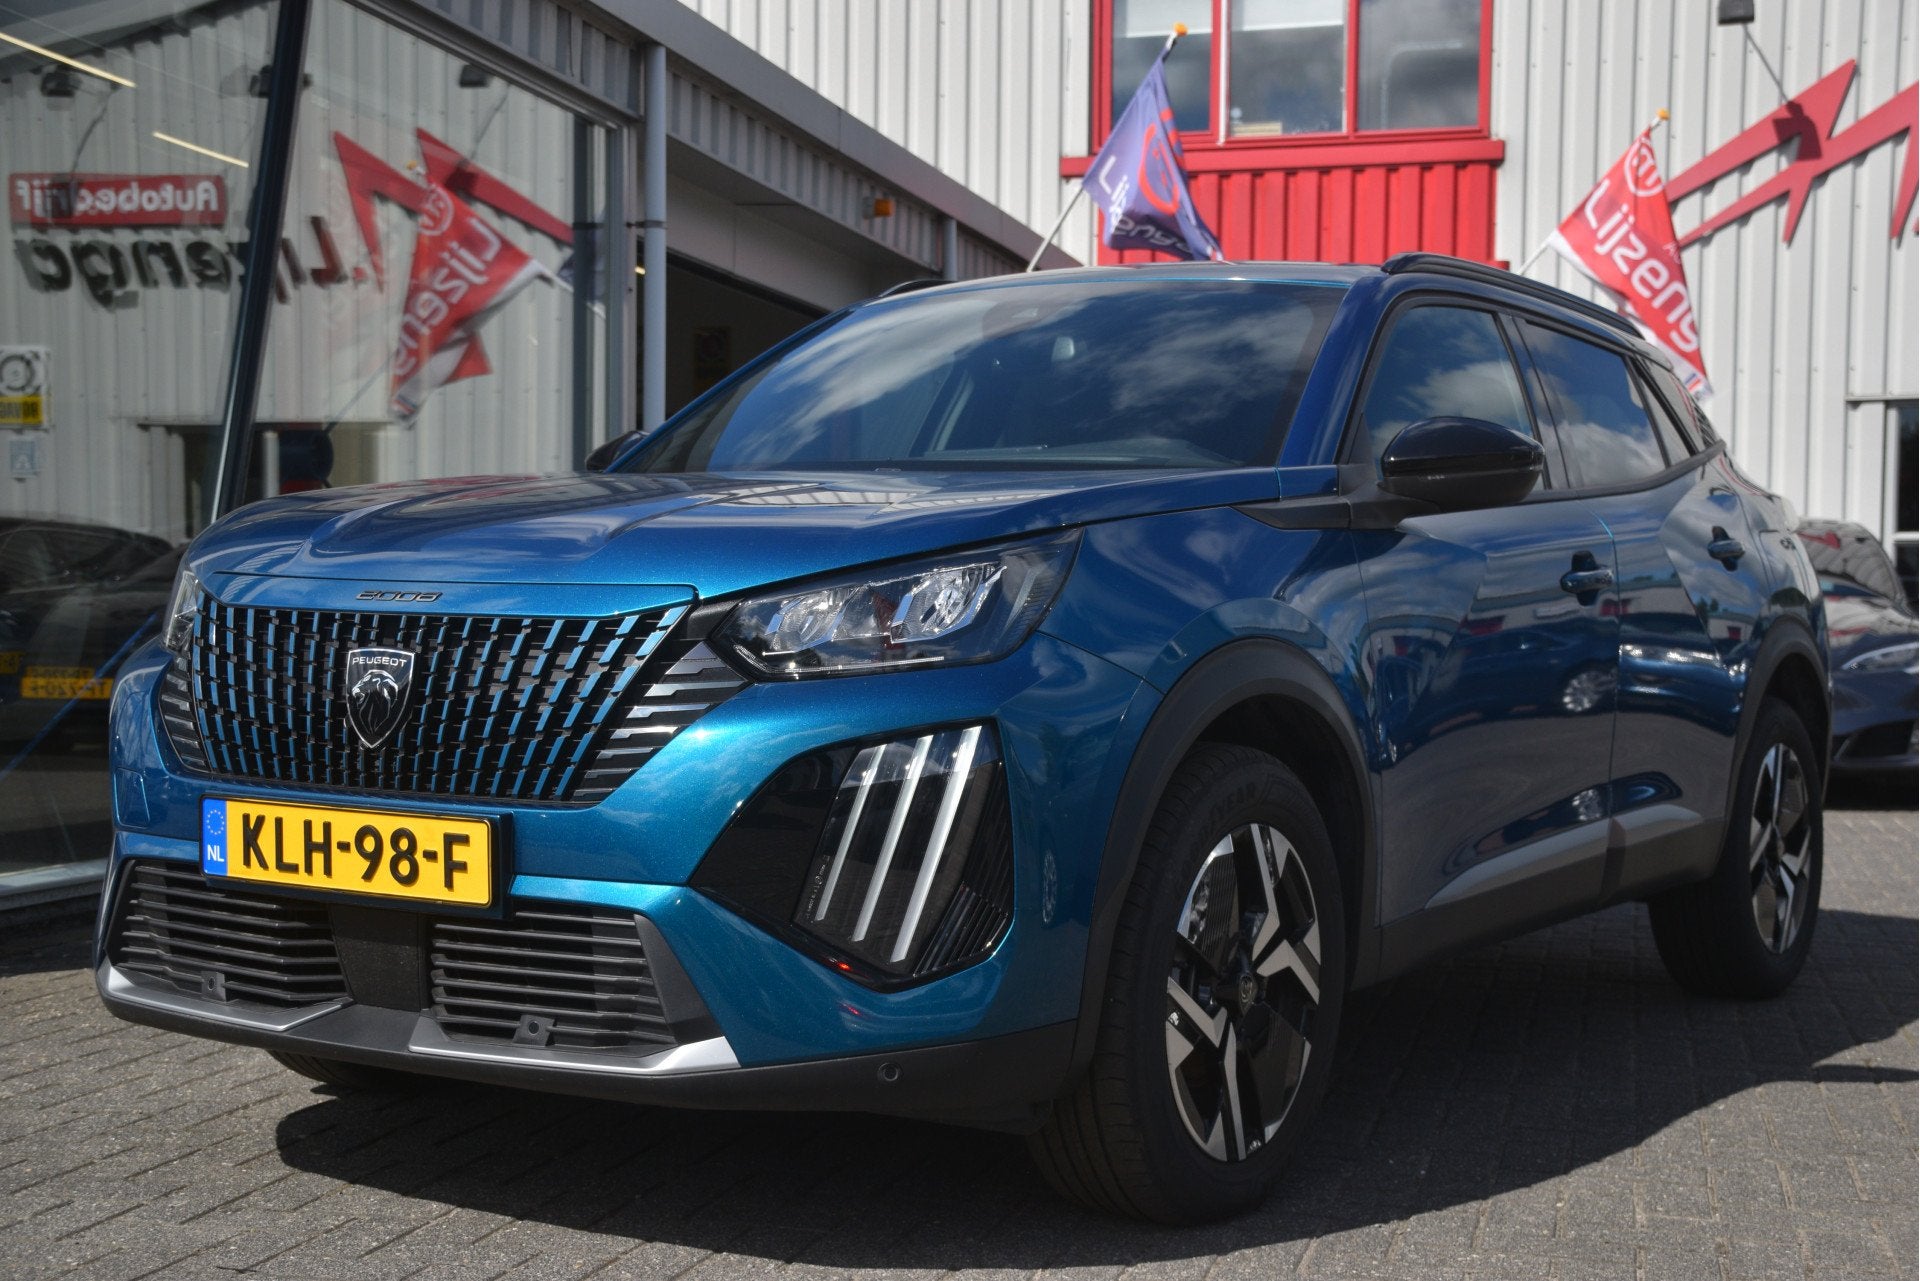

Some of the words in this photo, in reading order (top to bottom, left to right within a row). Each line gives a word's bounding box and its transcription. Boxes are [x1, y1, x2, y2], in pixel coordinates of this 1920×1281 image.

[355, 590, 443, 603] 2008
[351, 656, 408, 667] PEUGEOT
[206, 843, 225, 863] NL
[241, 812, 471, 891] KLH-98-F
